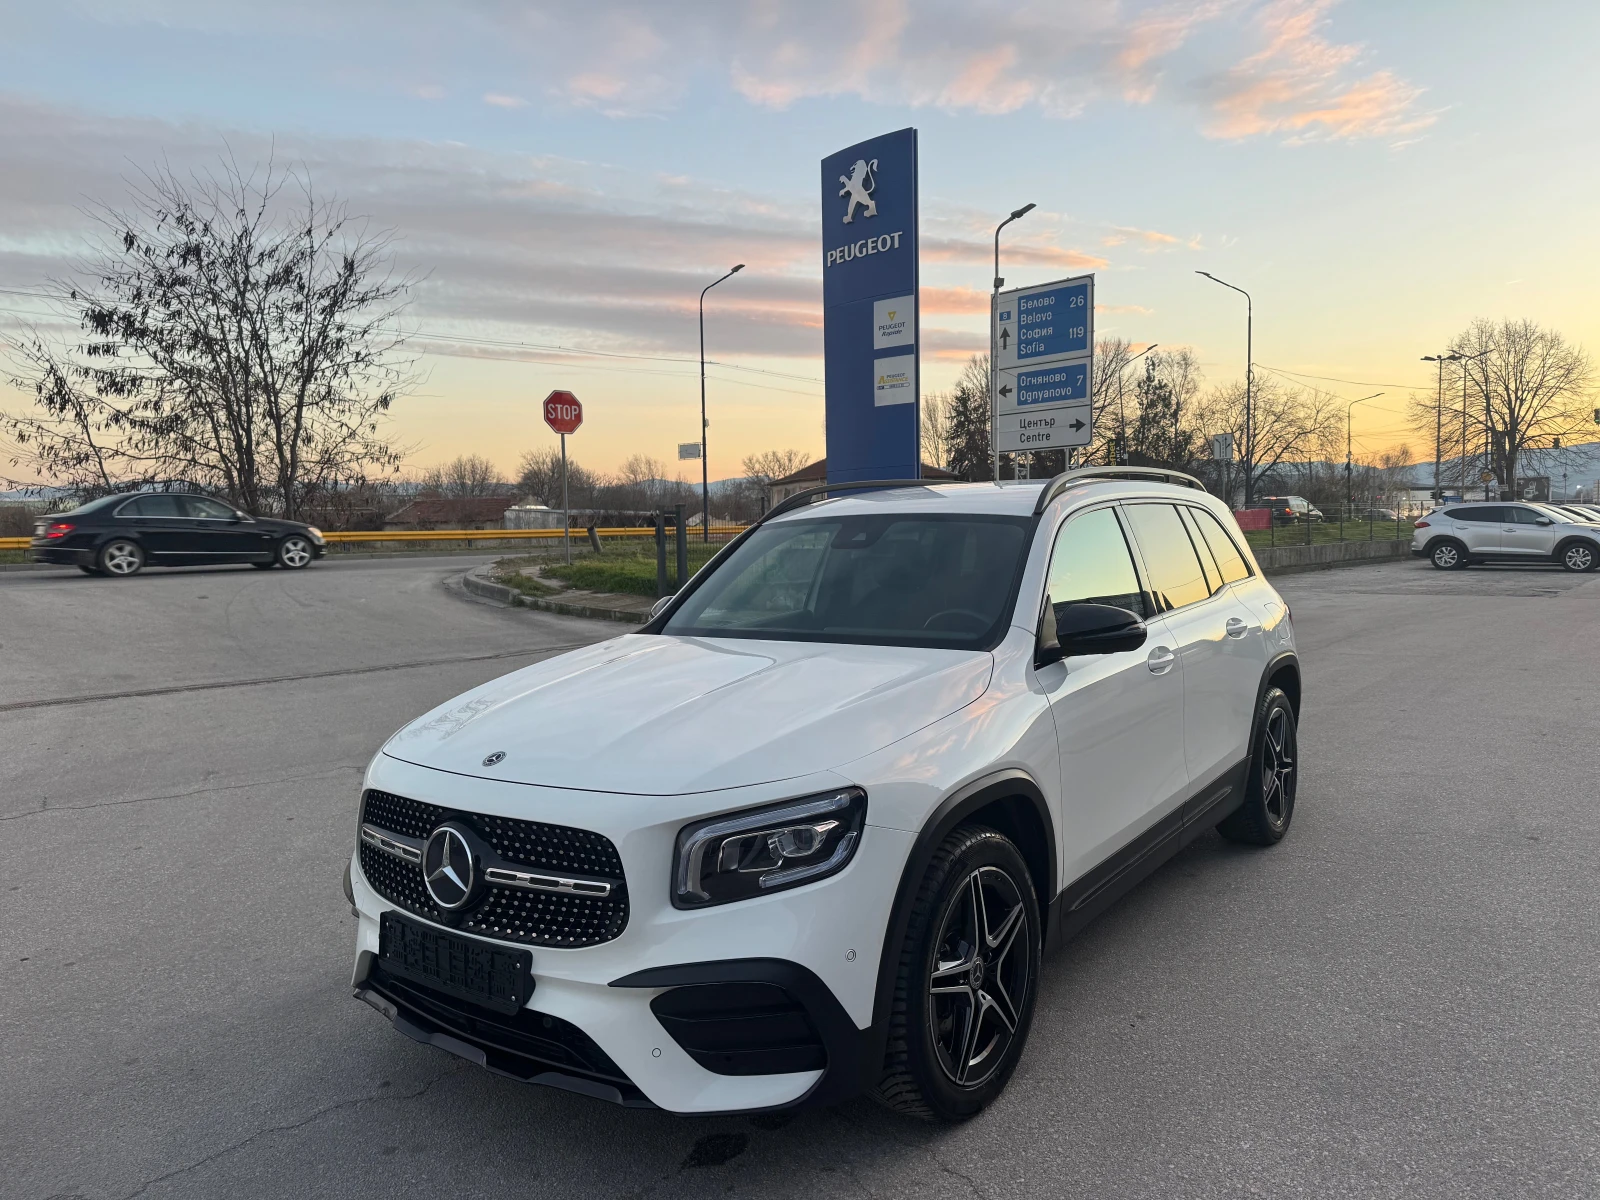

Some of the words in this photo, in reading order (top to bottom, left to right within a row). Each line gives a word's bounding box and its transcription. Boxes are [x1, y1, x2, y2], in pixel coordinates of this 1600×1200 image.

[827, 231, 903, 267] PEUGEOT
[1020, 296, 1055, 310] Белово
[1069, 295, 1085, 308] 26
[1003, 312, 1008, 320] 8
[1020, 311, 1052, 325] Belovo
[878, 321, 906, 331] PEUGEOT
[1020, 327, 1053, 340] София
[1068, 326, 1084, 339] 119
[1020, 342, 1045, 354] Sofia
[1020, 373, 1067, 387] Огняново
[1076, 375, 1084, 386] 7
[1020, 387, 1072, 402] Ognyanovo
[547, 403, 579, 420] STOP
[1020, 418, 1056, 430] Център
[1020, 432, 1051, 443] Centre
